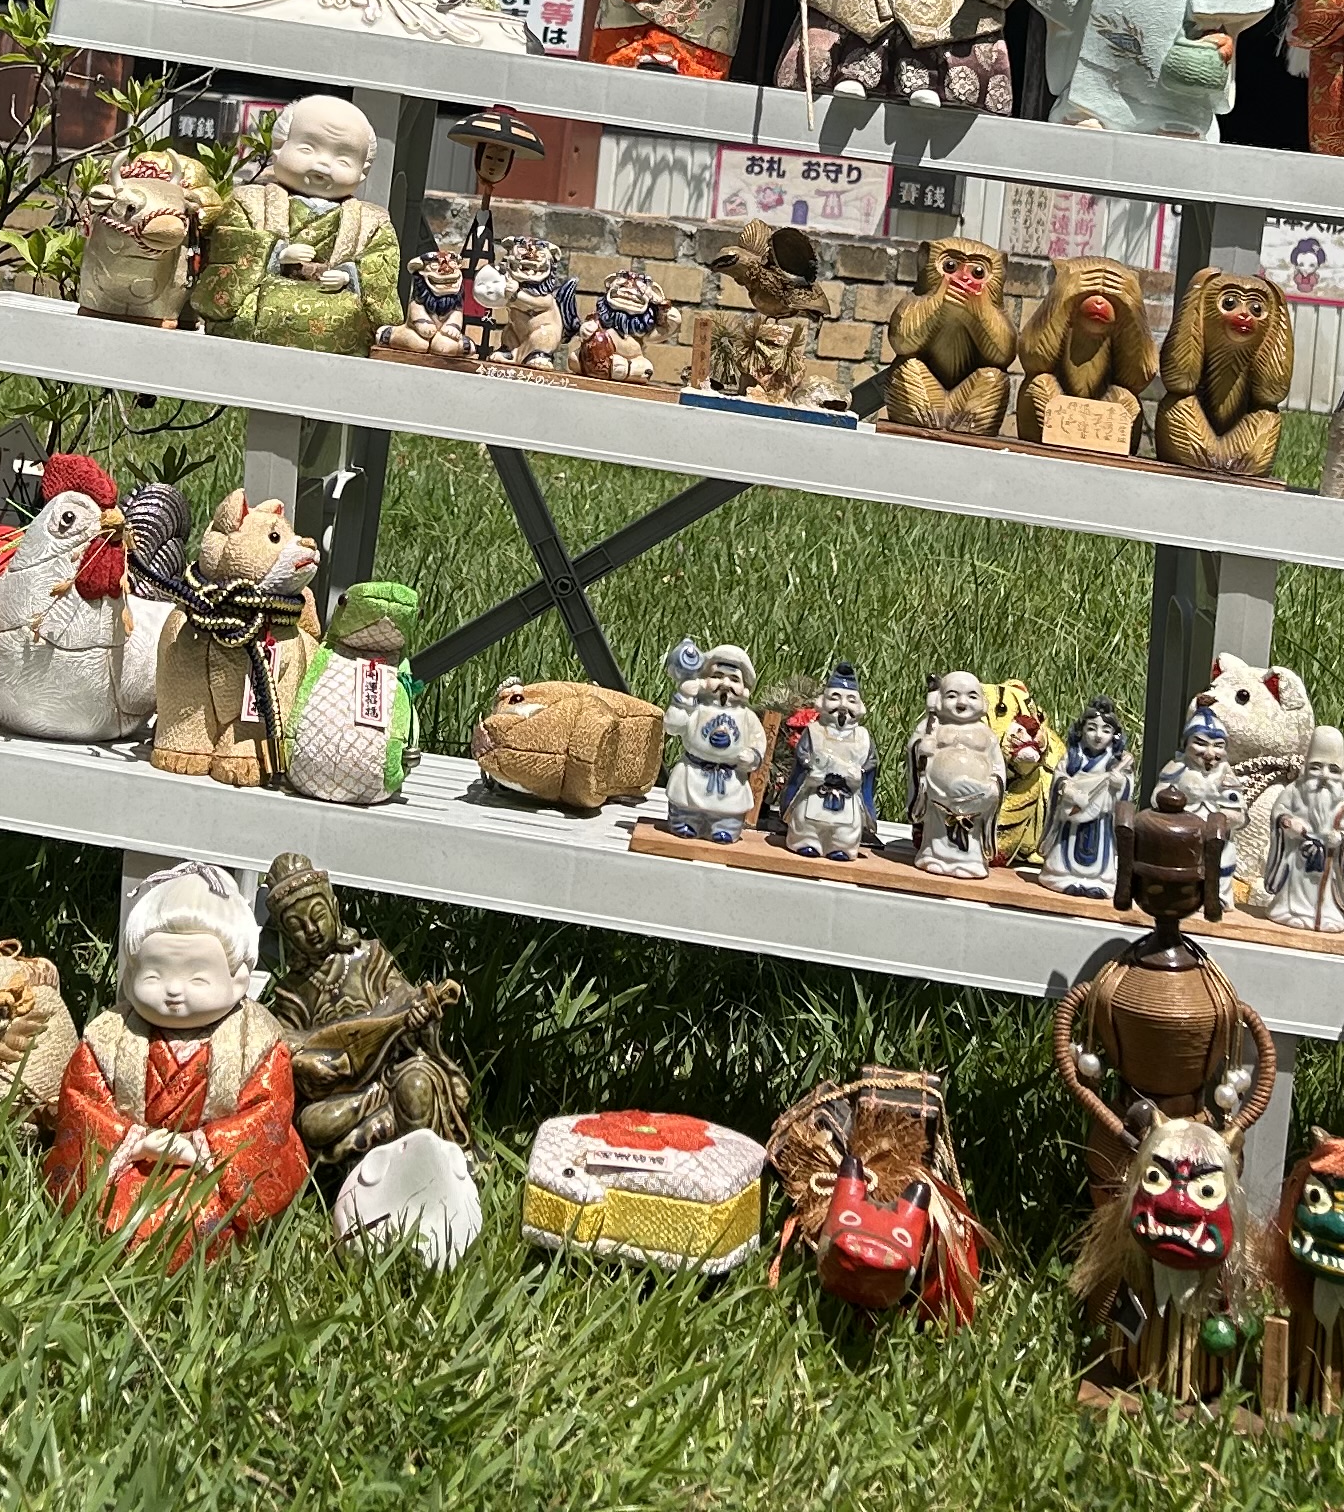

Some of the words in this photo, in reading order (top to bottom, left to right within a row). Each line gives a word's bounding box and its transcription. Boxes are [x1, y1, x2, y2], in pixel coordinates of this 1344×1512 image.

[745, 155, 786, 179] お札
[801, 160, 863, 185] お守り
